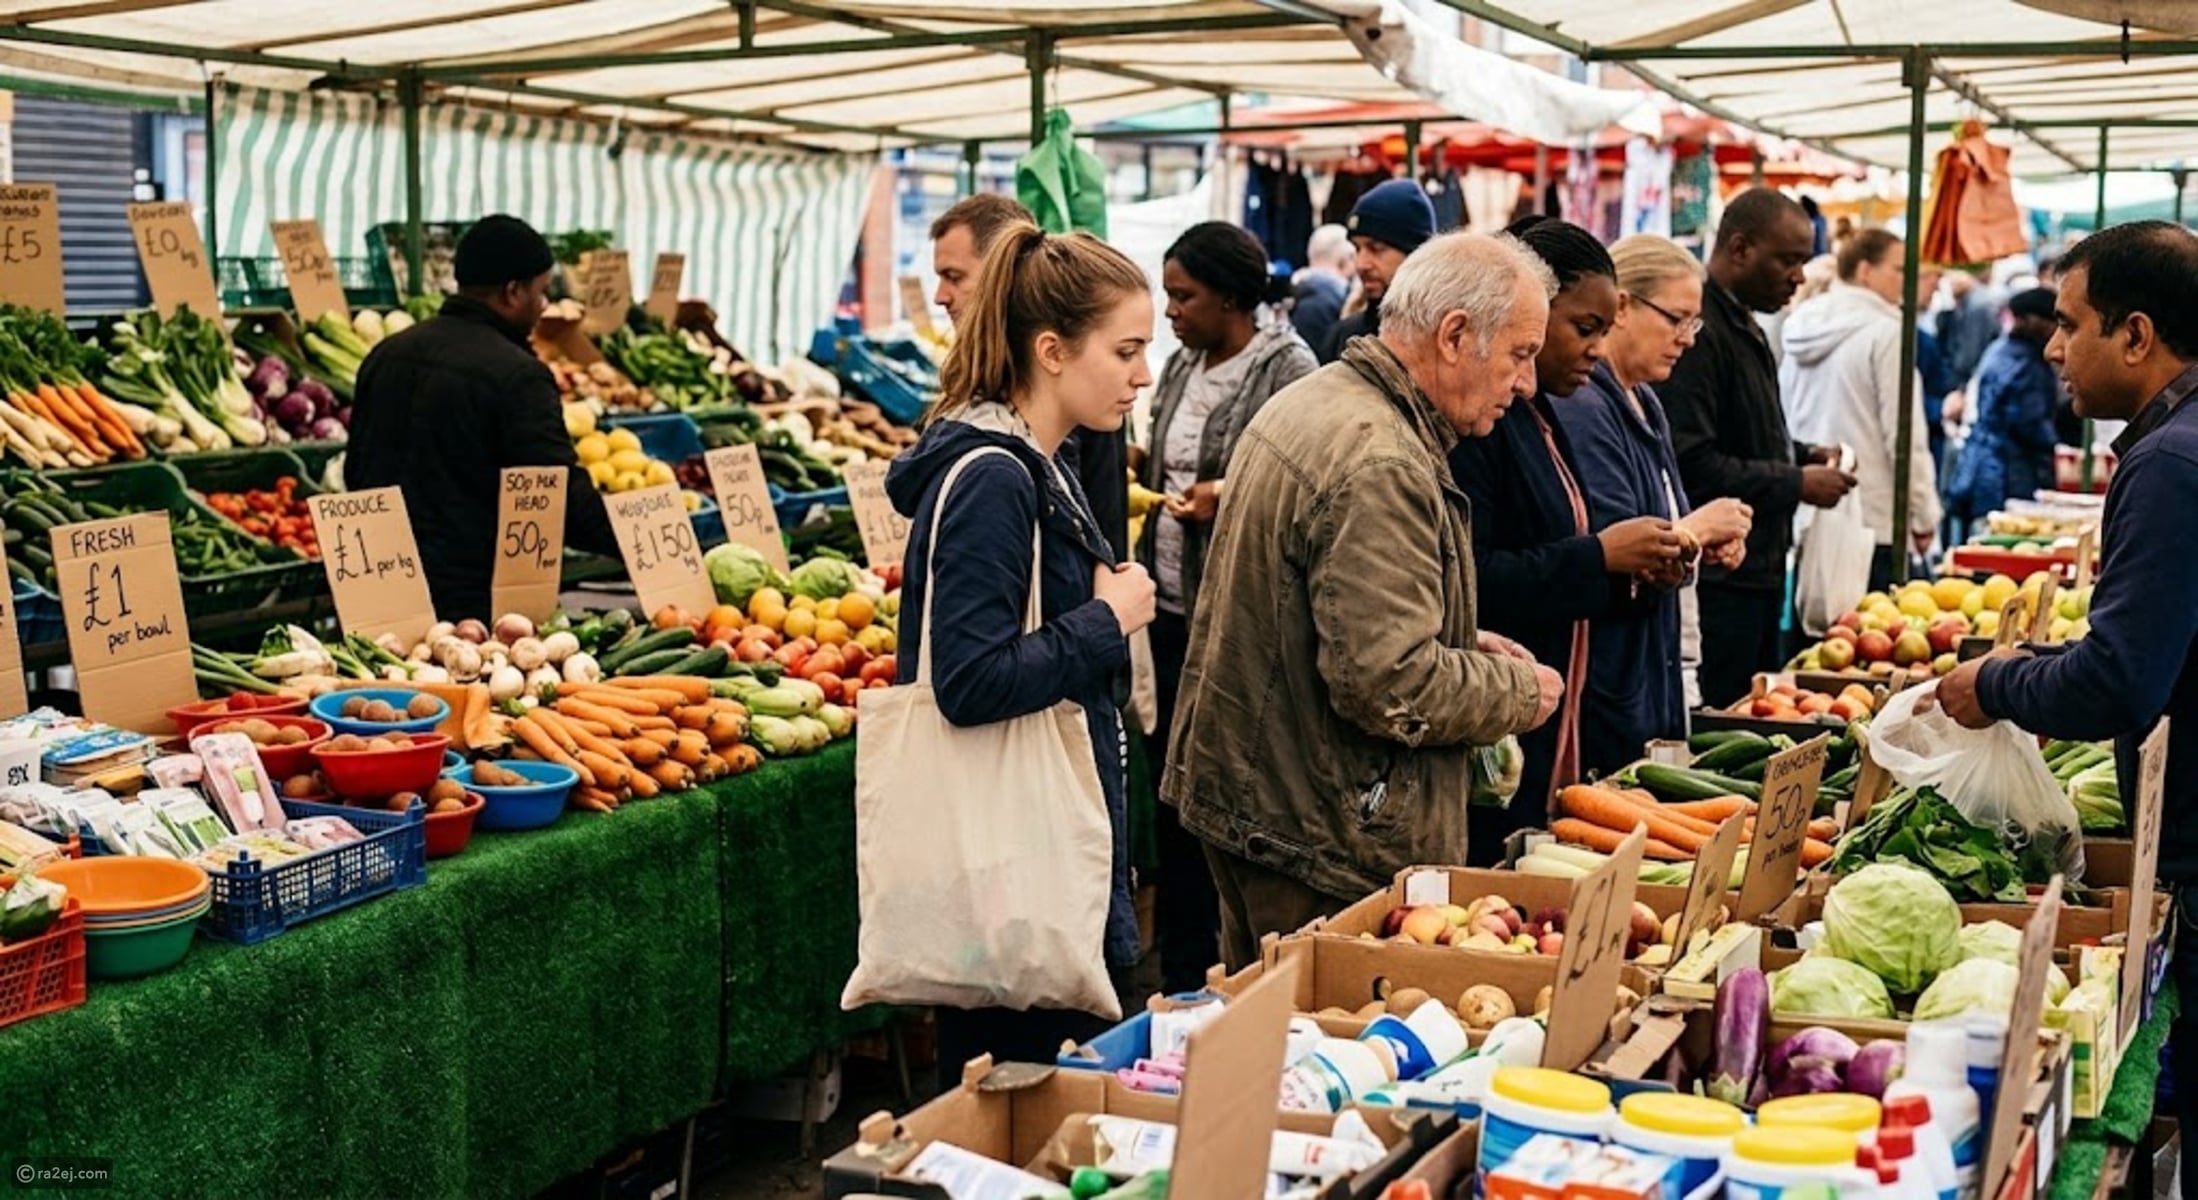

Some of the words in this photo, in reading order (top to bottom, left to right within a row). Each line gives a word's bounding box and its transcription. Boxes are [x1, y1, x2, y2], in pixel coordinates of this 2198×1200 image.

[0, 225, 42, 264] £5
[514, 495, 550, 512] HEAD
[71, 524, 136, 558] FRESH
[334, 523, 374, 582] £1
[377, 559, 395, 579] per
[397, 552, 416, 578] kg
[504, 520, 548, 569] 50p
[632, 521, 693, 571] £150
[84, 562, 132, 632] £1
[107, 630, 131, 655] per
[135, 614, 172, 640] bowl
